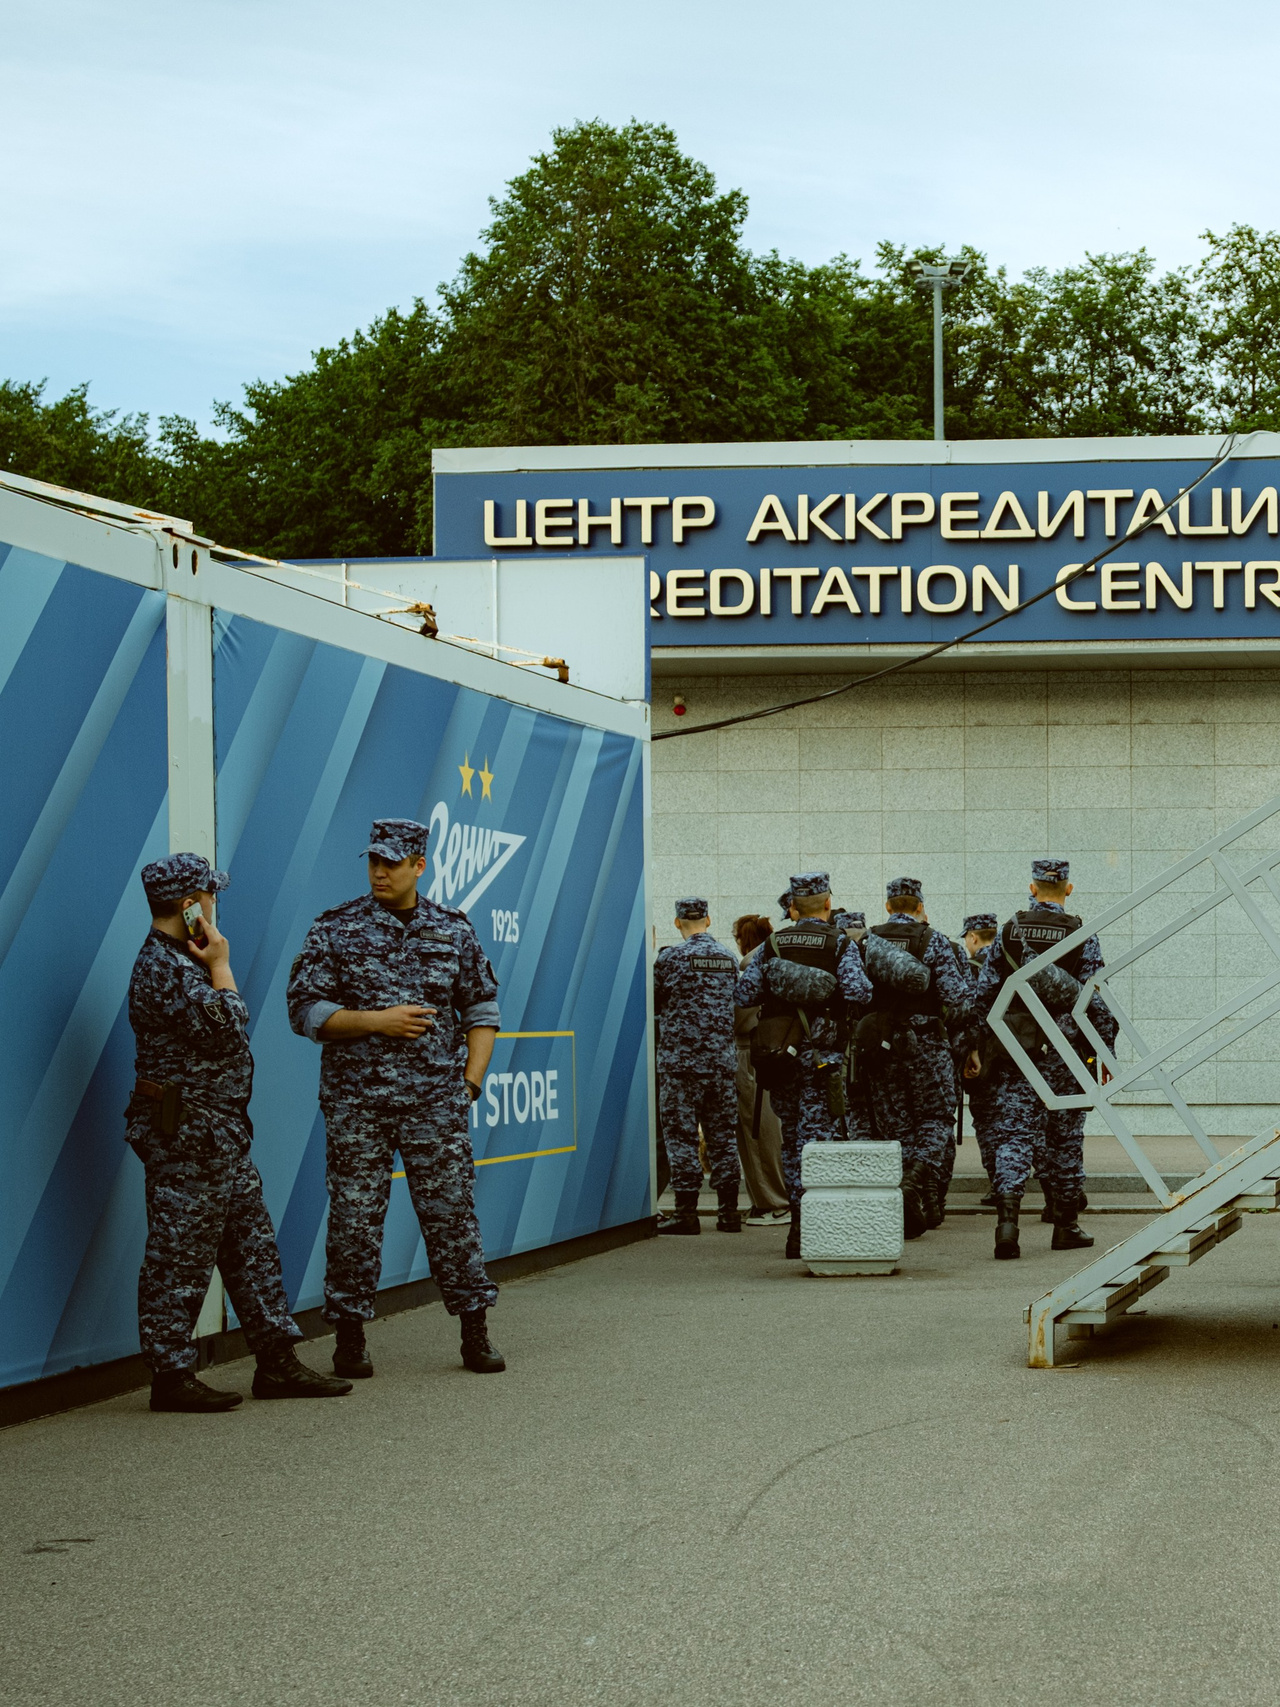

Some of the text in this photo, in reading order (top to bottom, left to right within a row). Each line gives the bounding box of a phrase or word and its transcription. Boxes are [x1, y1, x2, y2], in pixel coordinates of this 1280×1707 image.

[484, 496, 715, 546] ЦЕНТР
[650, 565, 1019, 616] EDITATION
[491, 909, 520, 943] 1925
[775, 934, 823, 946] РОСГВАРДИЯ
[693, 958, 733, 970] РОСГВАРДИЯ
[485, 1069, 559, 1127] STORE
